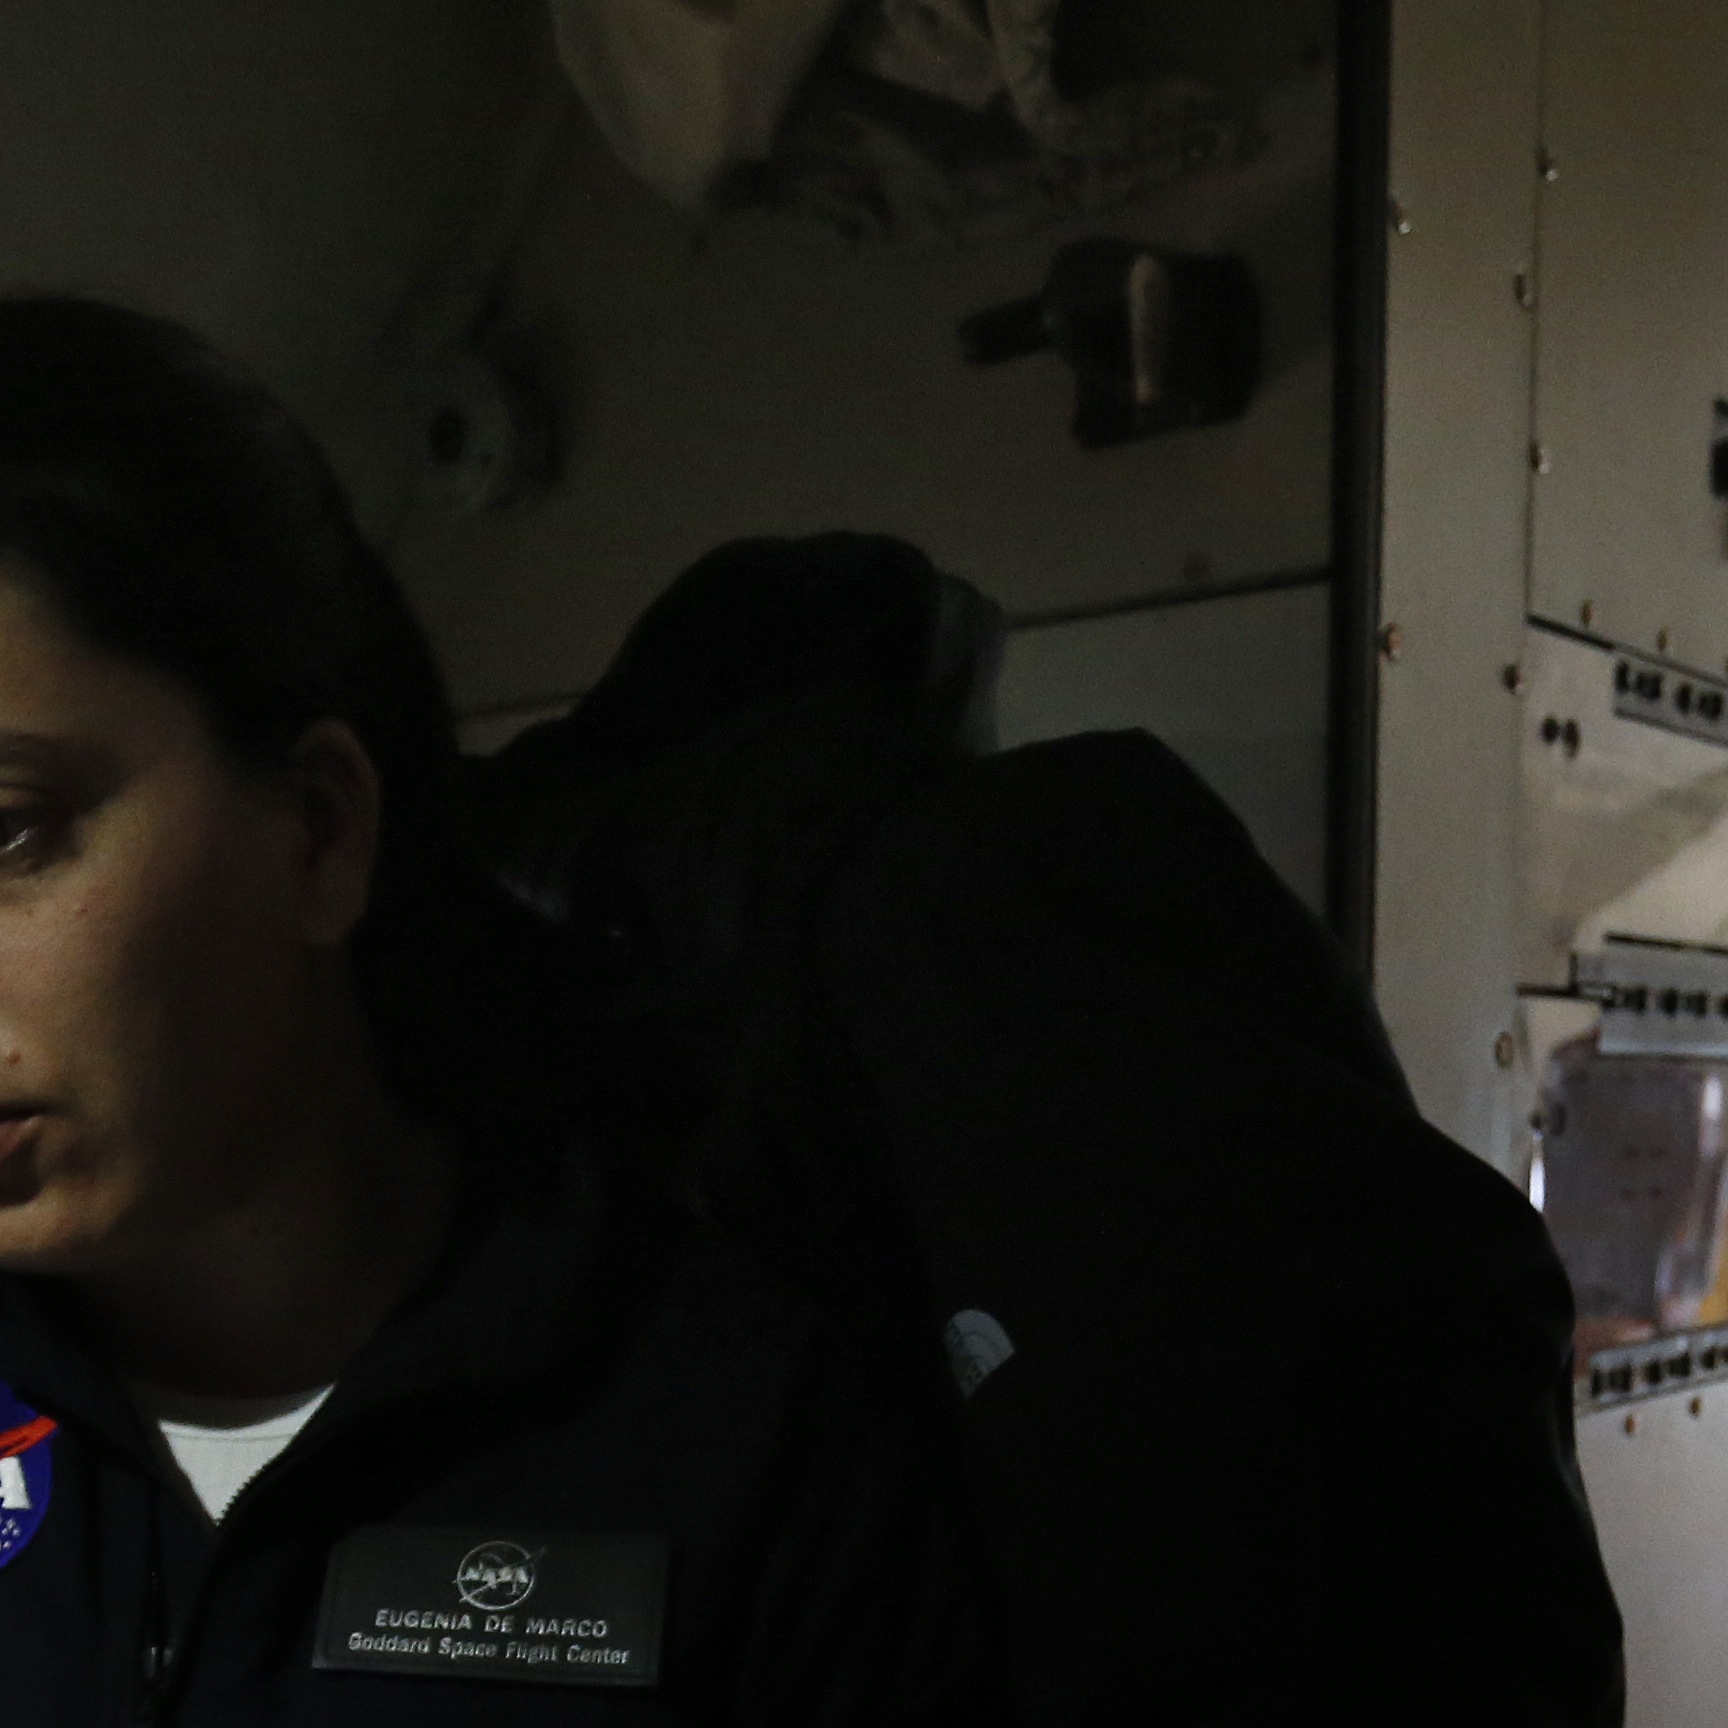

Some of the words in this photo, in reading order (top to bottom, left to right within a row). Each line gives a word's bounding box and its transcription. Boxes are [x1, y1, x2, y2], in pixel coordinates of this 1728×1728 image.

[375, 1608, 473, 1631] EUGENIA
[484, 1614, 515, 1633] DE
[525, 1616, 609, 1638] MARCO
[348, 1631, 431, 1654] Goddard
[437, 1636, 499, 1660] Space
[505, 1641, 559, 1664] Flight
[566, 1644, 631, 1665] Center
